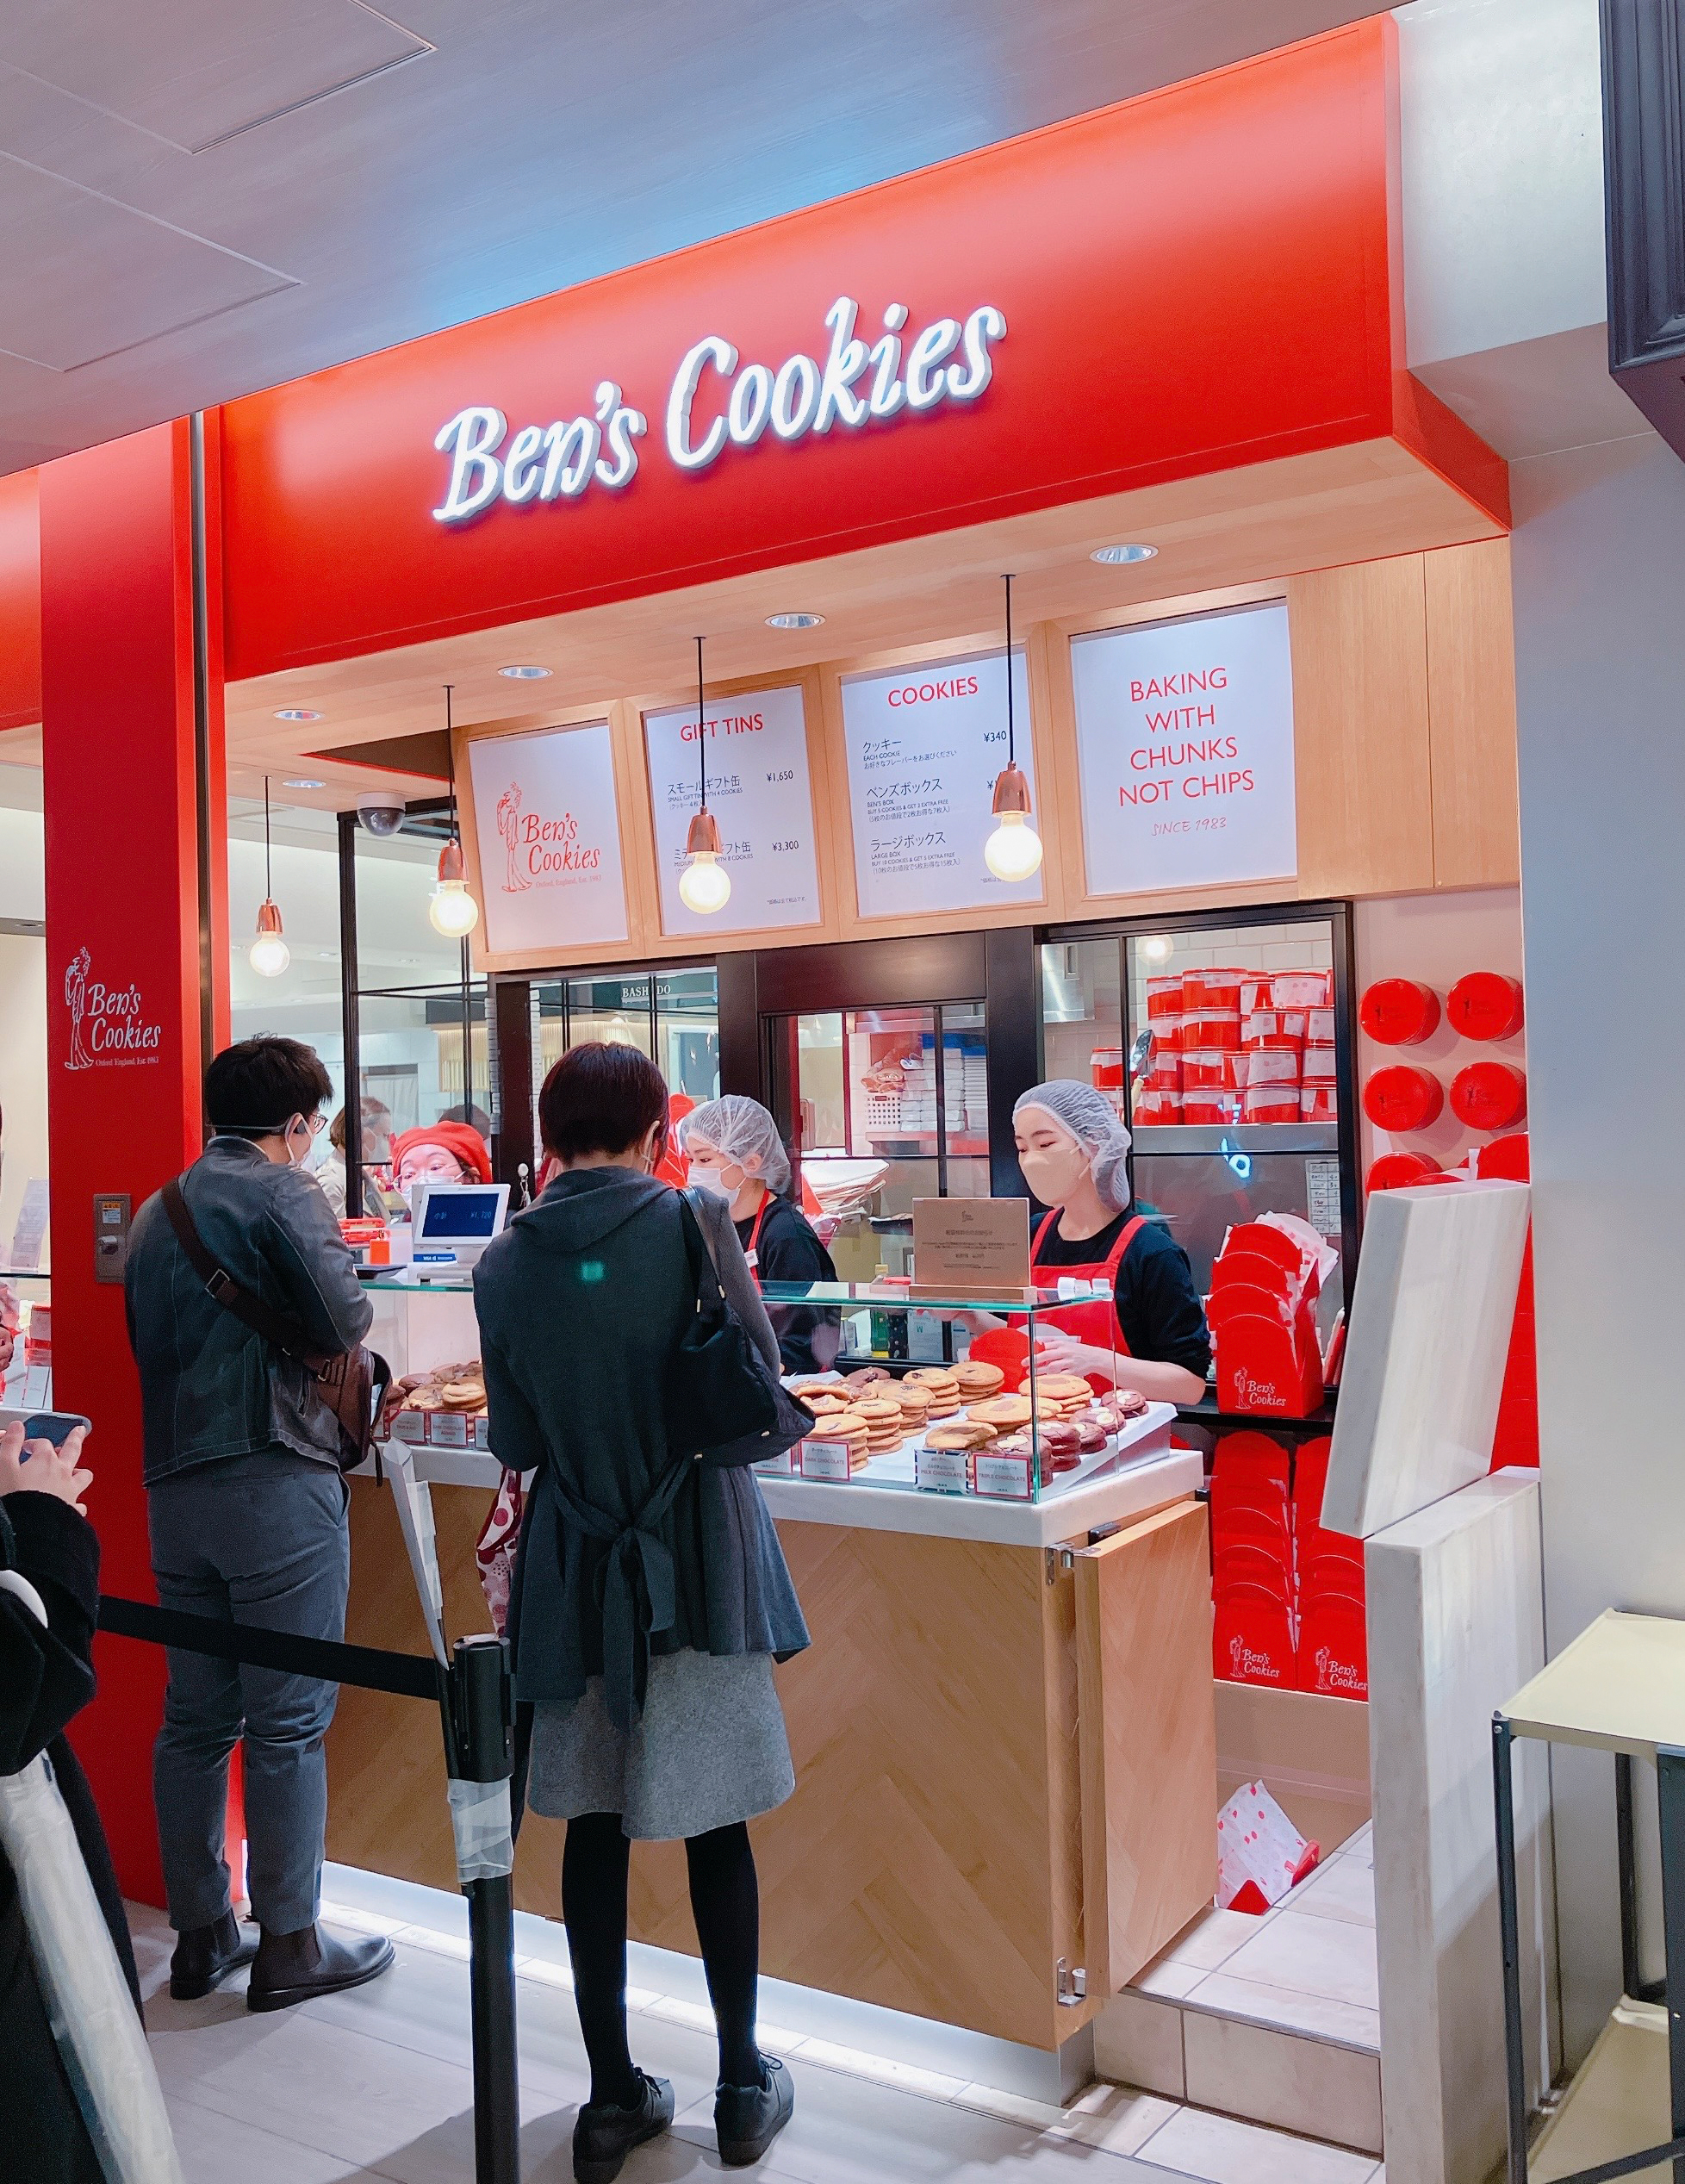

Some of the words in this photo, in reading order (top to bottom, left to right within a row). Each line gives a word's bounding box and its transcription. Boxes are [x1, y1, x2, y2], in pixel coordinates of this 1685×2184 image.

[432, 381, 647, 522] Ben's
[666, 296, 1007, 468] Cookies
[887, 676, 979, 706] COOKIES
[1130, 667, 1228, 702] BAKING
[681, 720, 718, 741] GIFT
[722, 714, 763, 735] TINS
[1146, 705, 1215, 732] WITH
[862, 738, 901, 754] クッキー
[984, 731, 1007, 743] ¥340
[879, 750, 900, 759] COOKIE
[1130, 737, 1238, 770] CHUNKS
[767, 770, 793, 781] ¥1,650
[866, 778, 942, 799] ベンズボックス
[1119, 780, 1173, 806] NOT
[1182, 769, 1254, 799] CHIPS
[522, 812, 578, 843] Ben's
[1152, 820, 1190, 836] SINCE
[1196, 817, 1227, 831] 1983
[772, 841, 799, 851] ¥3,300
[871, 832, 946, 852] ラージボックス
[529, 840, 600, 874] Cookies
[88, 984, 141, 1016] Ben's
[91, 1015, 161, 1051] Cookies
[1247, 1380, 1275, 1394] Ben's
[1249, 1392, 1286, 1406] Cookies
[932, 1470, 962, 1478] CHOCOLATE
[1241, 1649, 1270, 1664] Ben's
[1244, 1662, 1280, 1678] Cookies
[1328, 1661, 1358, 1677] Ben's
[1330, 1674, 1368, 1691] Cookies
